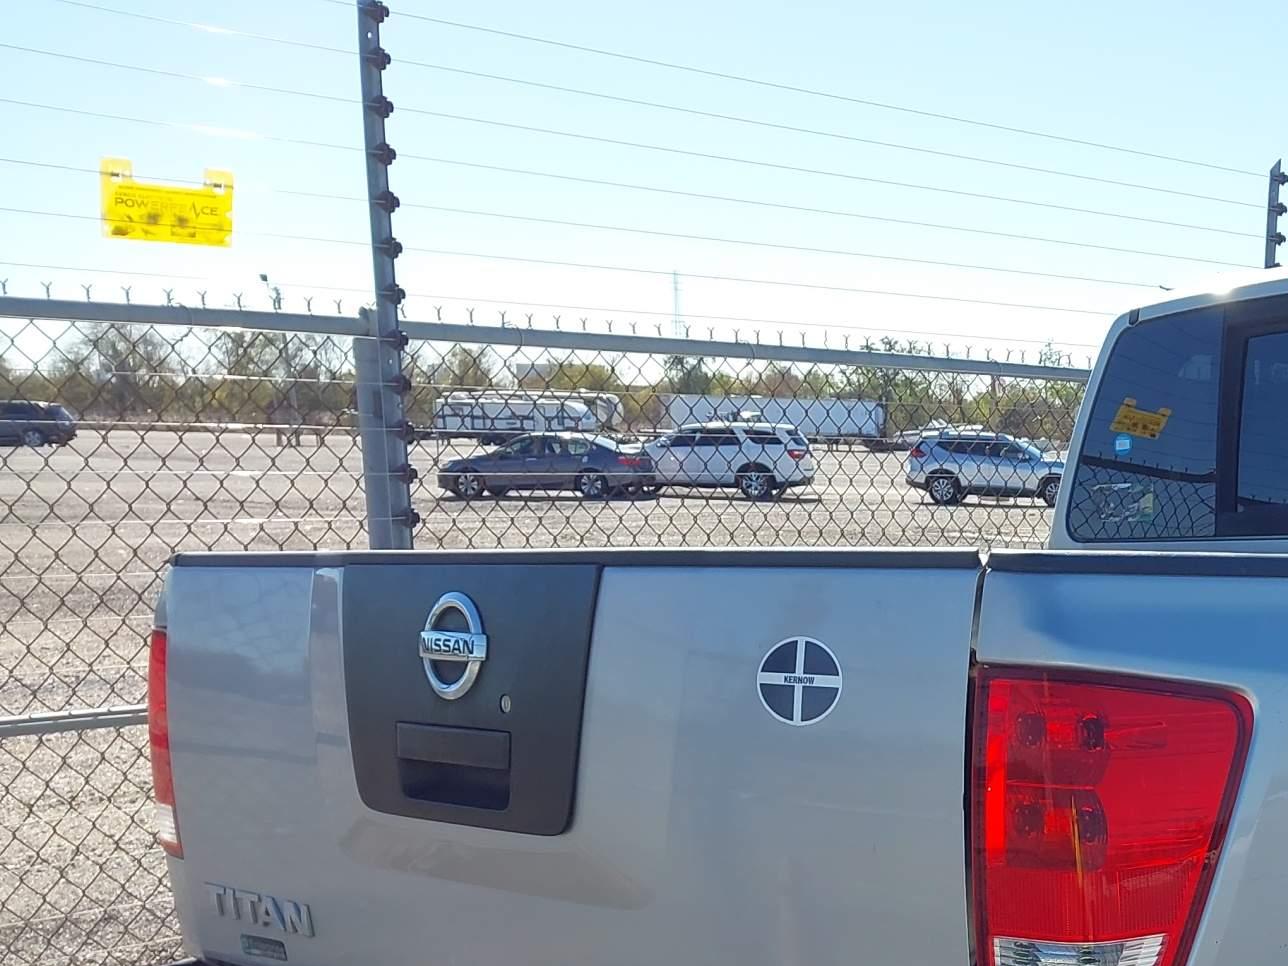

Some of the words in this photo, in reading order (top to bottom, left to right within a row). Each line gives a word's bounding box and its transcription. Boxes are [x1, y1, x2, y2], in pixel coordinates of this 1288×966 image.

[422, 637, 475, 655] NISSAN
[783, 675, 815, 685] KERNOW
[204, 881, 316, 938] TITAN
